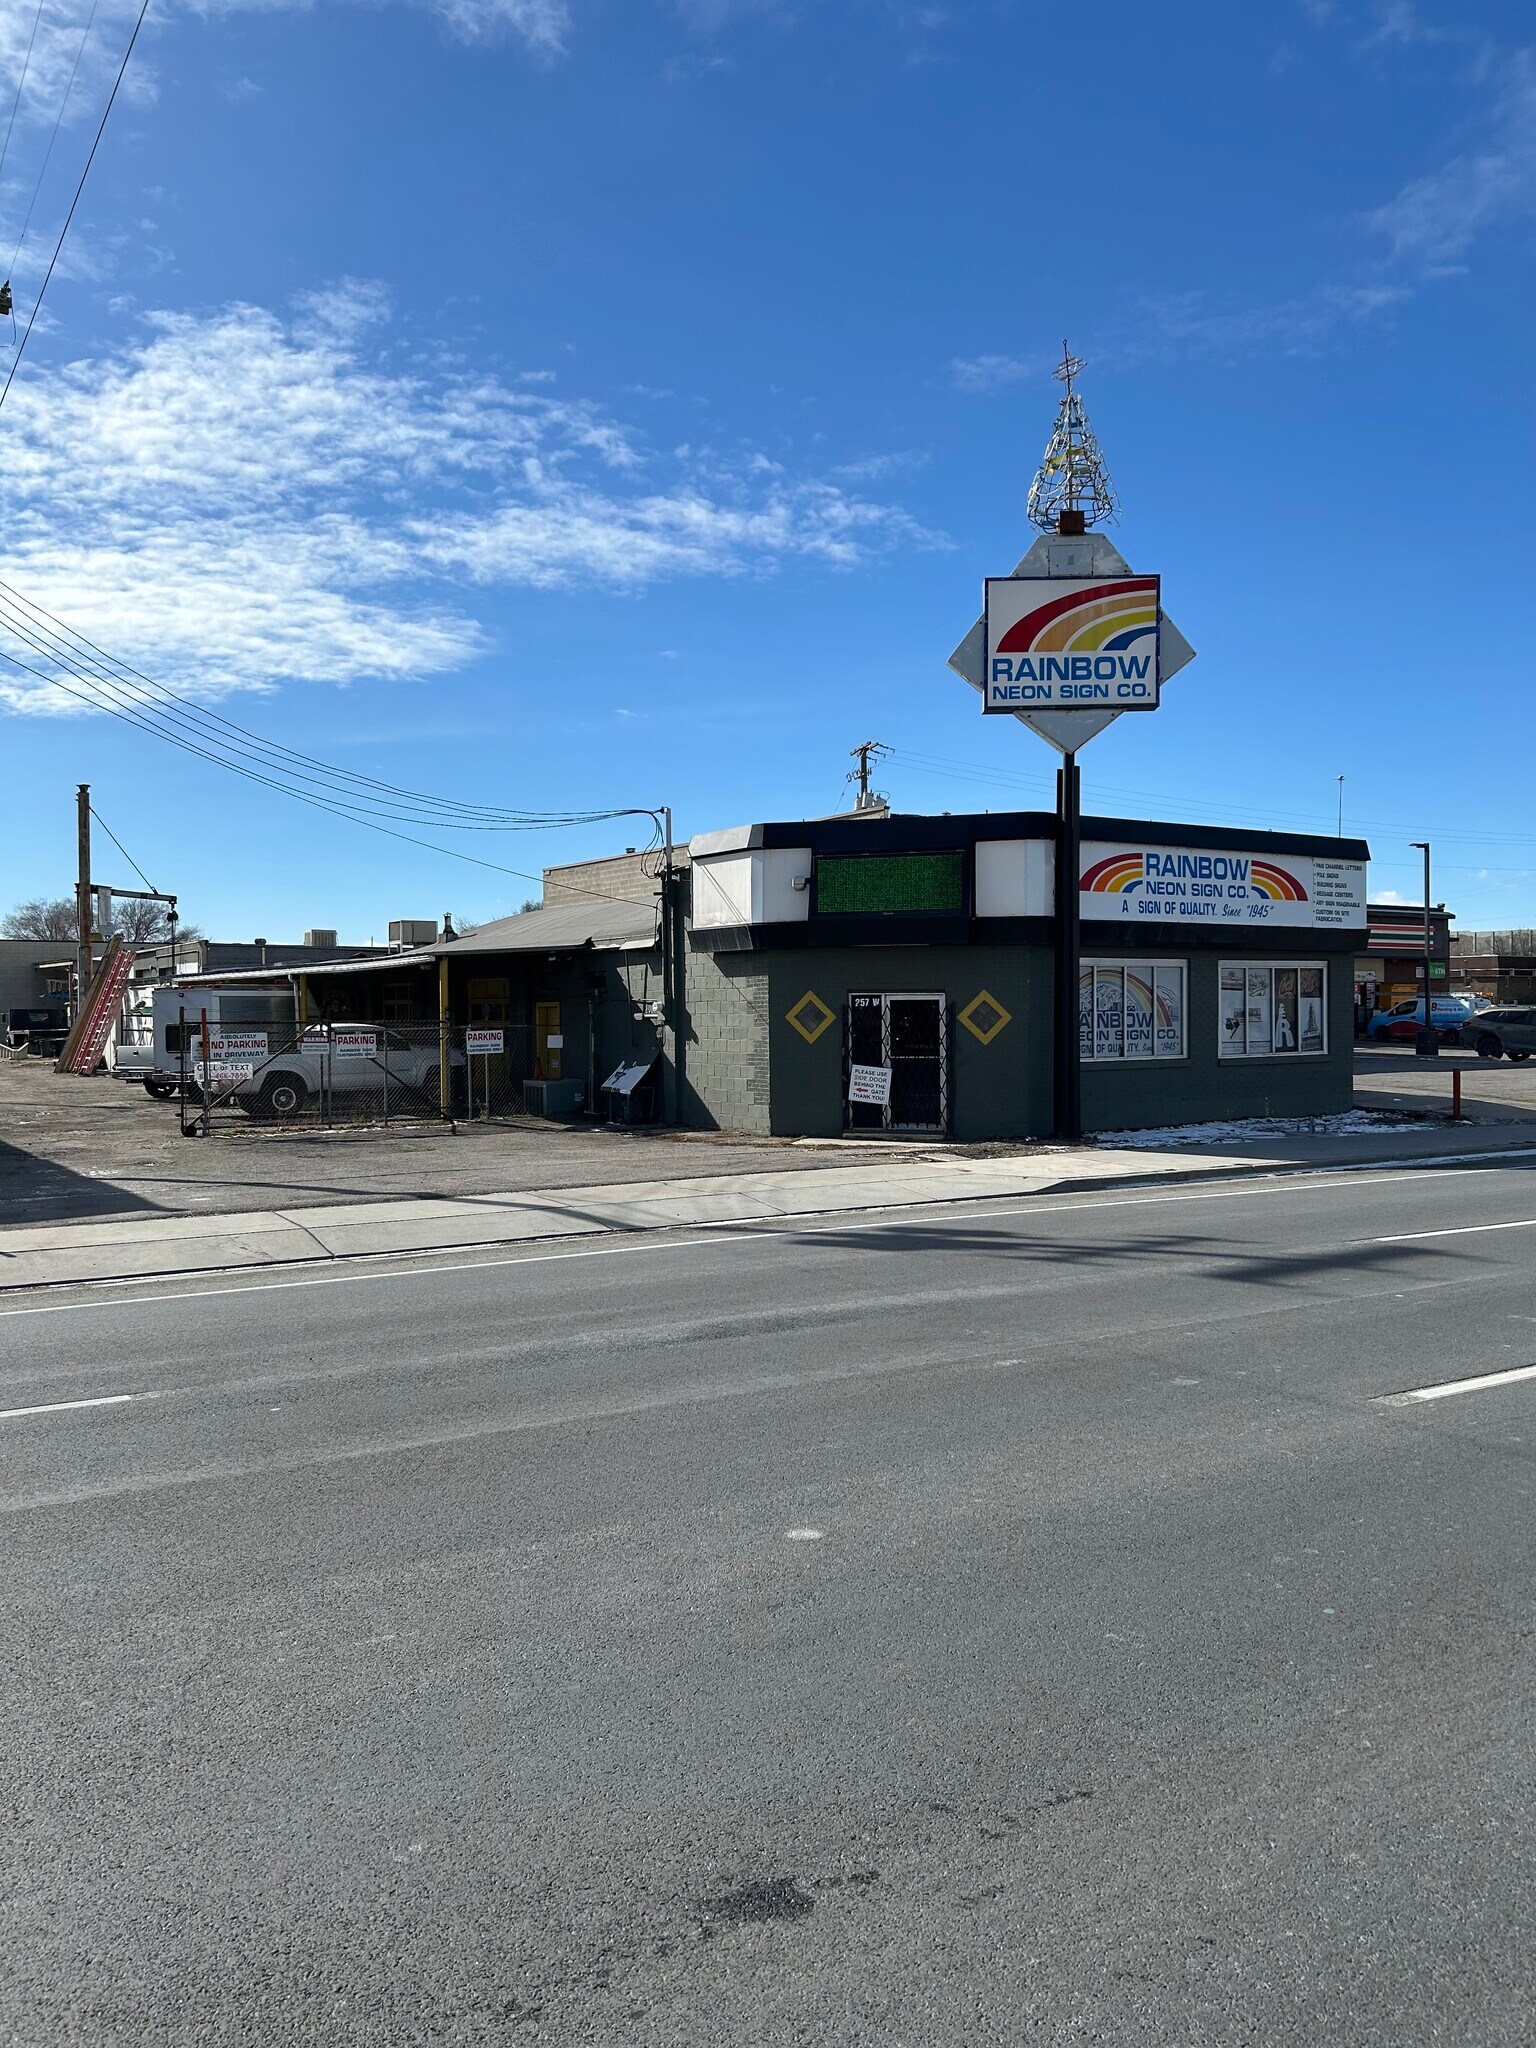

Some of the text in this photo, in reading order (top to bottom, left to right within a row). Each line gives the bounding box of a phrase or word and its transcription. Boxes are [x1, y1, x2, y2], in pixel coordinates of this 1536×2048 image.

[992, 655, 1151, 682] RAINBOW
[992, 683, 1151, 700] NEON SIGN CO.
[1145, 853, 1249, 881] RAINBOW
[1145, 881, 1249, 899] NEON SIGN CO.
[1122, 900, 1129, 913] A
[1138, 900, 1161, 915] SIGN
[1164, 901, 1176, 915] OF
[1222, 904, 1242, 917] Since
[855, 998, 880, 1007] 257 W
[1080, 1012, 1153, 1028] ANBOW
[337, 1035, 375, 1045] PARKING
[467, 1032, 502, 1041] PARKING
[1157, 1029, 1179, 1039] CO.
[211, 1041, 225, 1050] NO
[228, 1040, 267, 1050] PARKING
[1096, 1044, 1106, 1053] OF
